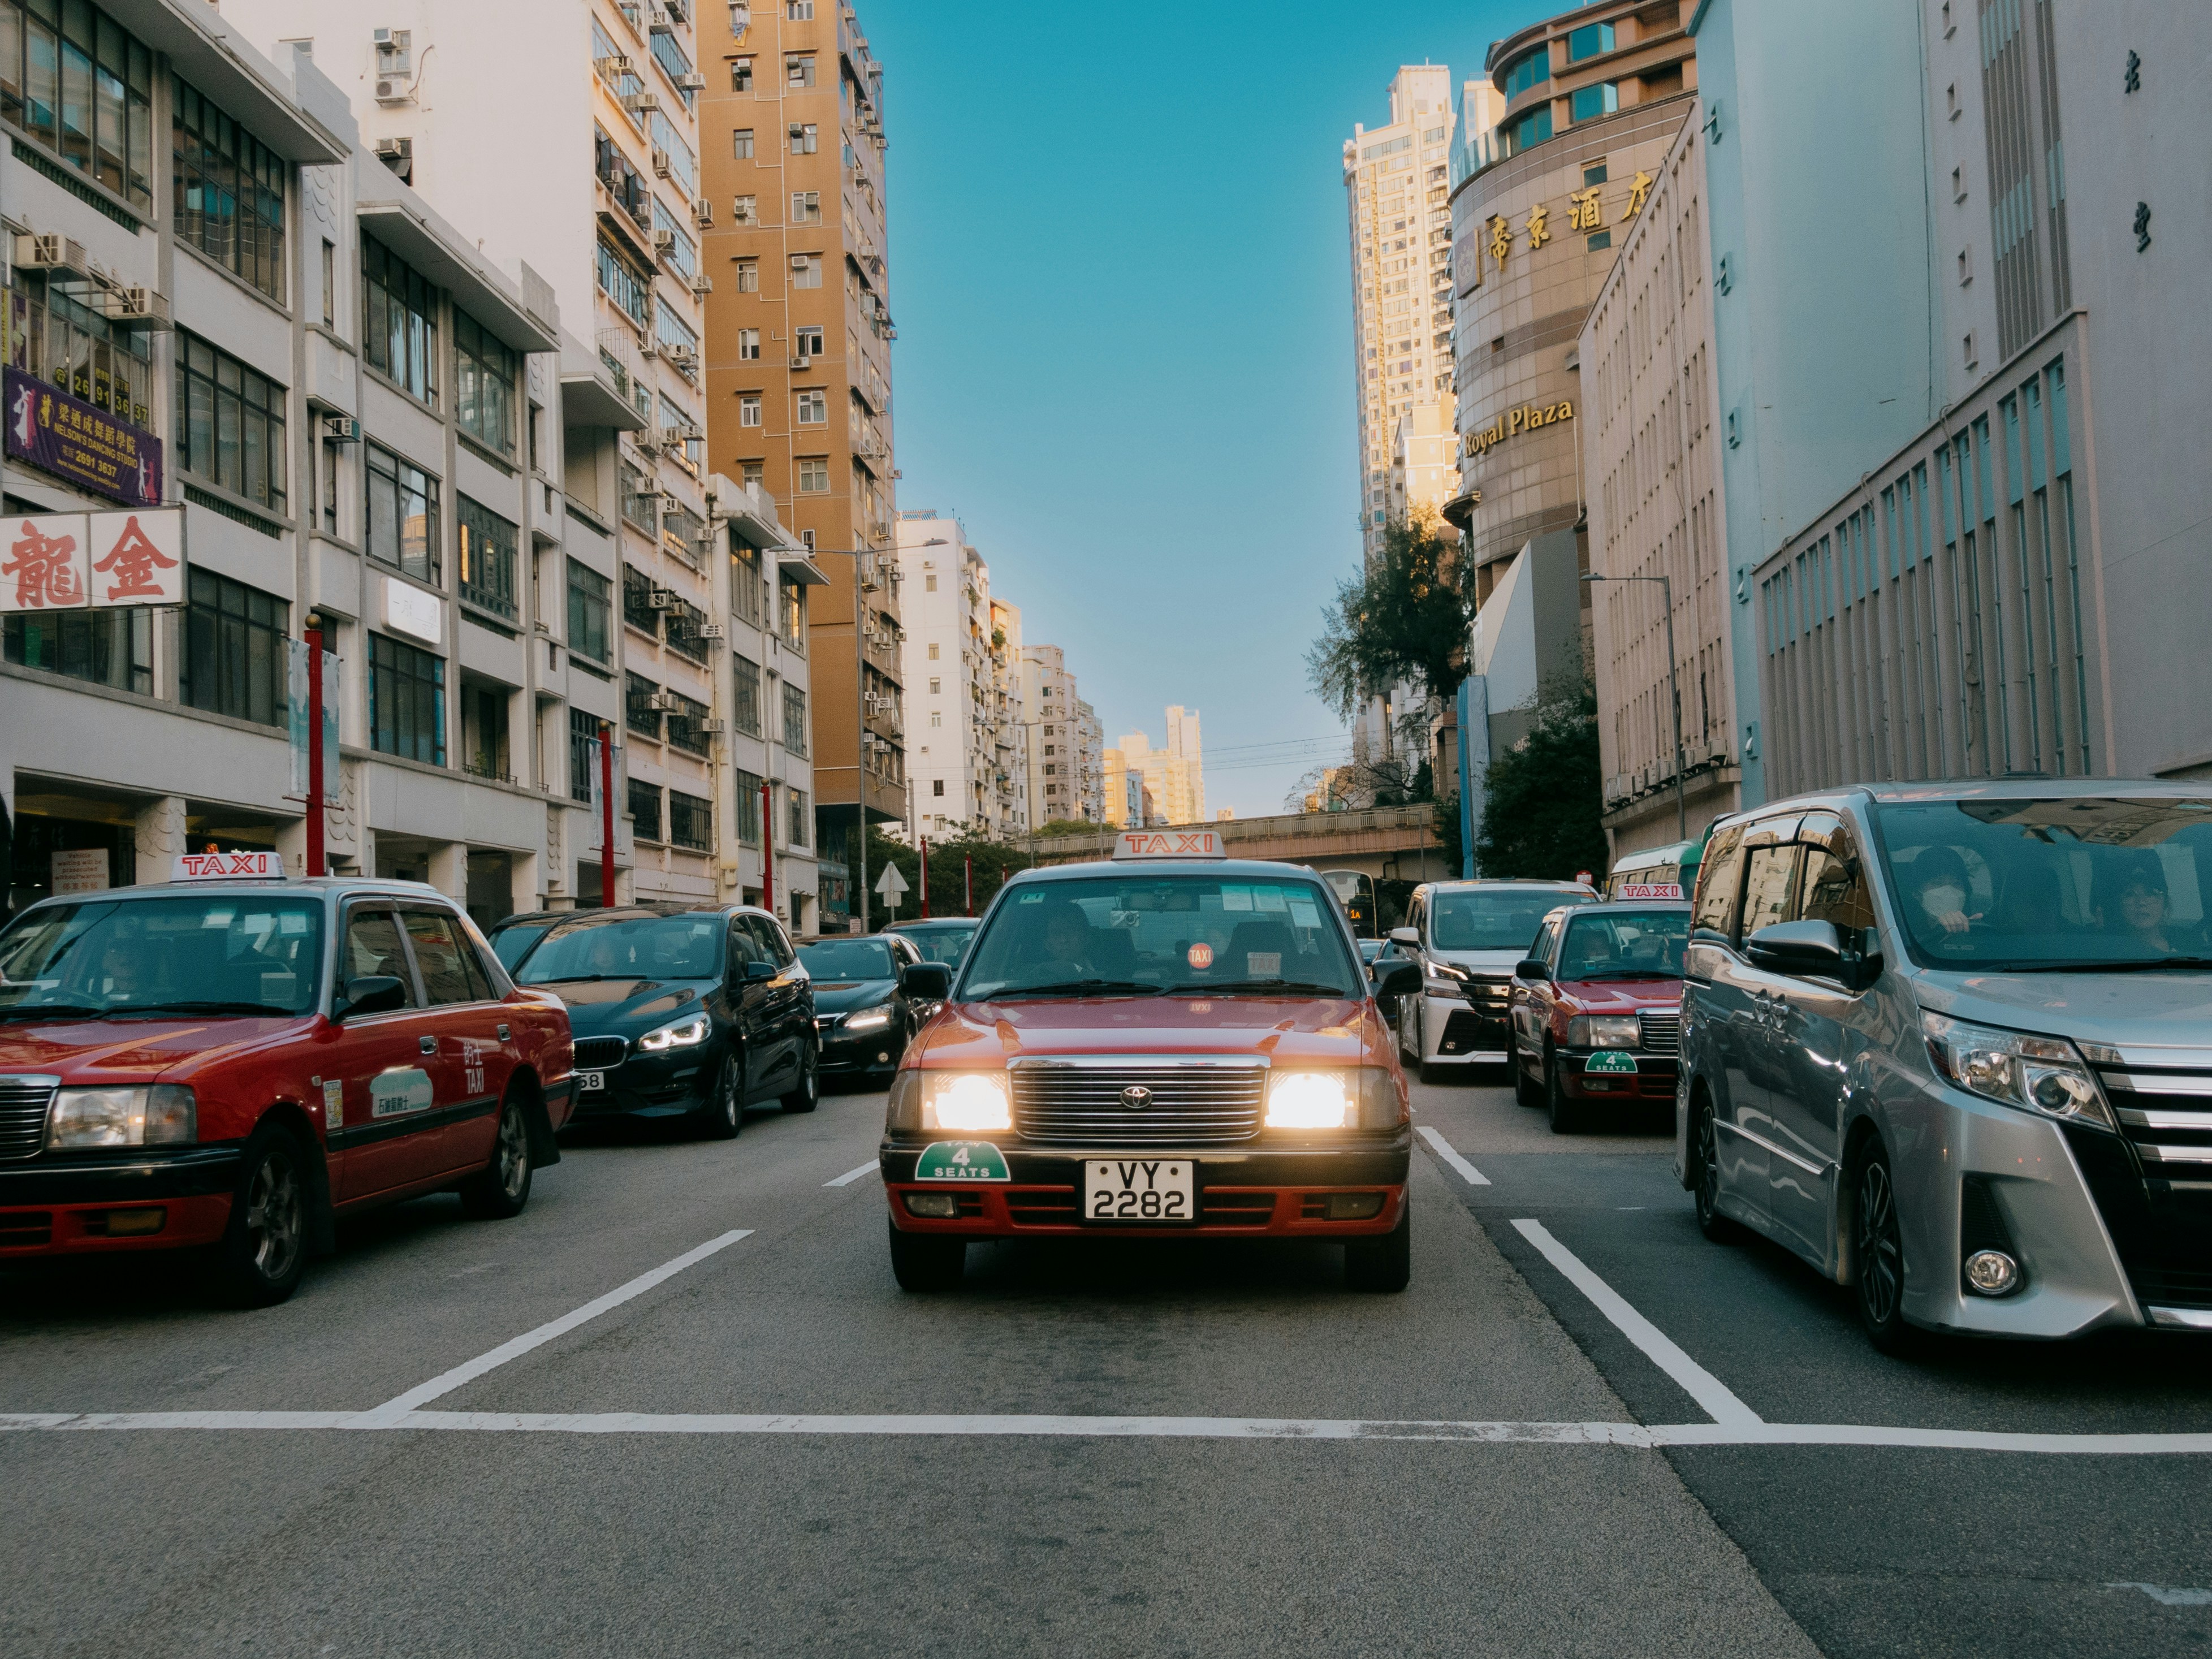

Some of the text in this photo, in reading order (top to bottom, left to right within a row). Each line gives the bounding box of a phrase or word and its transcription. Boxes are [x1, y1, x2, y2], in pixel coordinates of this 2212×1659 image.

[75, 375, 148, 422] 26 91 36 37
[1465, 401, 1573, 459] Royal Plaza
[75, 450, 95, 468] 2691
[98, 460, 117, 477] 3637
[88, 437, 116, 459] DANCING
[116, 451, 138, 469] STUDIO
[1125, 833, 1213, 853] TAXI
[182, 854, 266, 876] TAXI
[1624, 885, 1678, 897] TAXI
[1350, 909, 1361, 919] 1A
[1190, 949, 1211, 962] TAXI
[464, 1040, 483, 1066] 的士
[1606, 1055, 1616, 1065] 4
[465, 1068, 484, 1094] TAXI
[952, 1147, 970, 1166] 4
[935, 1168, 990, 1177] SEATS
[1117, 1162, 1160, 1190] VY
[1094, 1190, 1185, 1218] 2282
